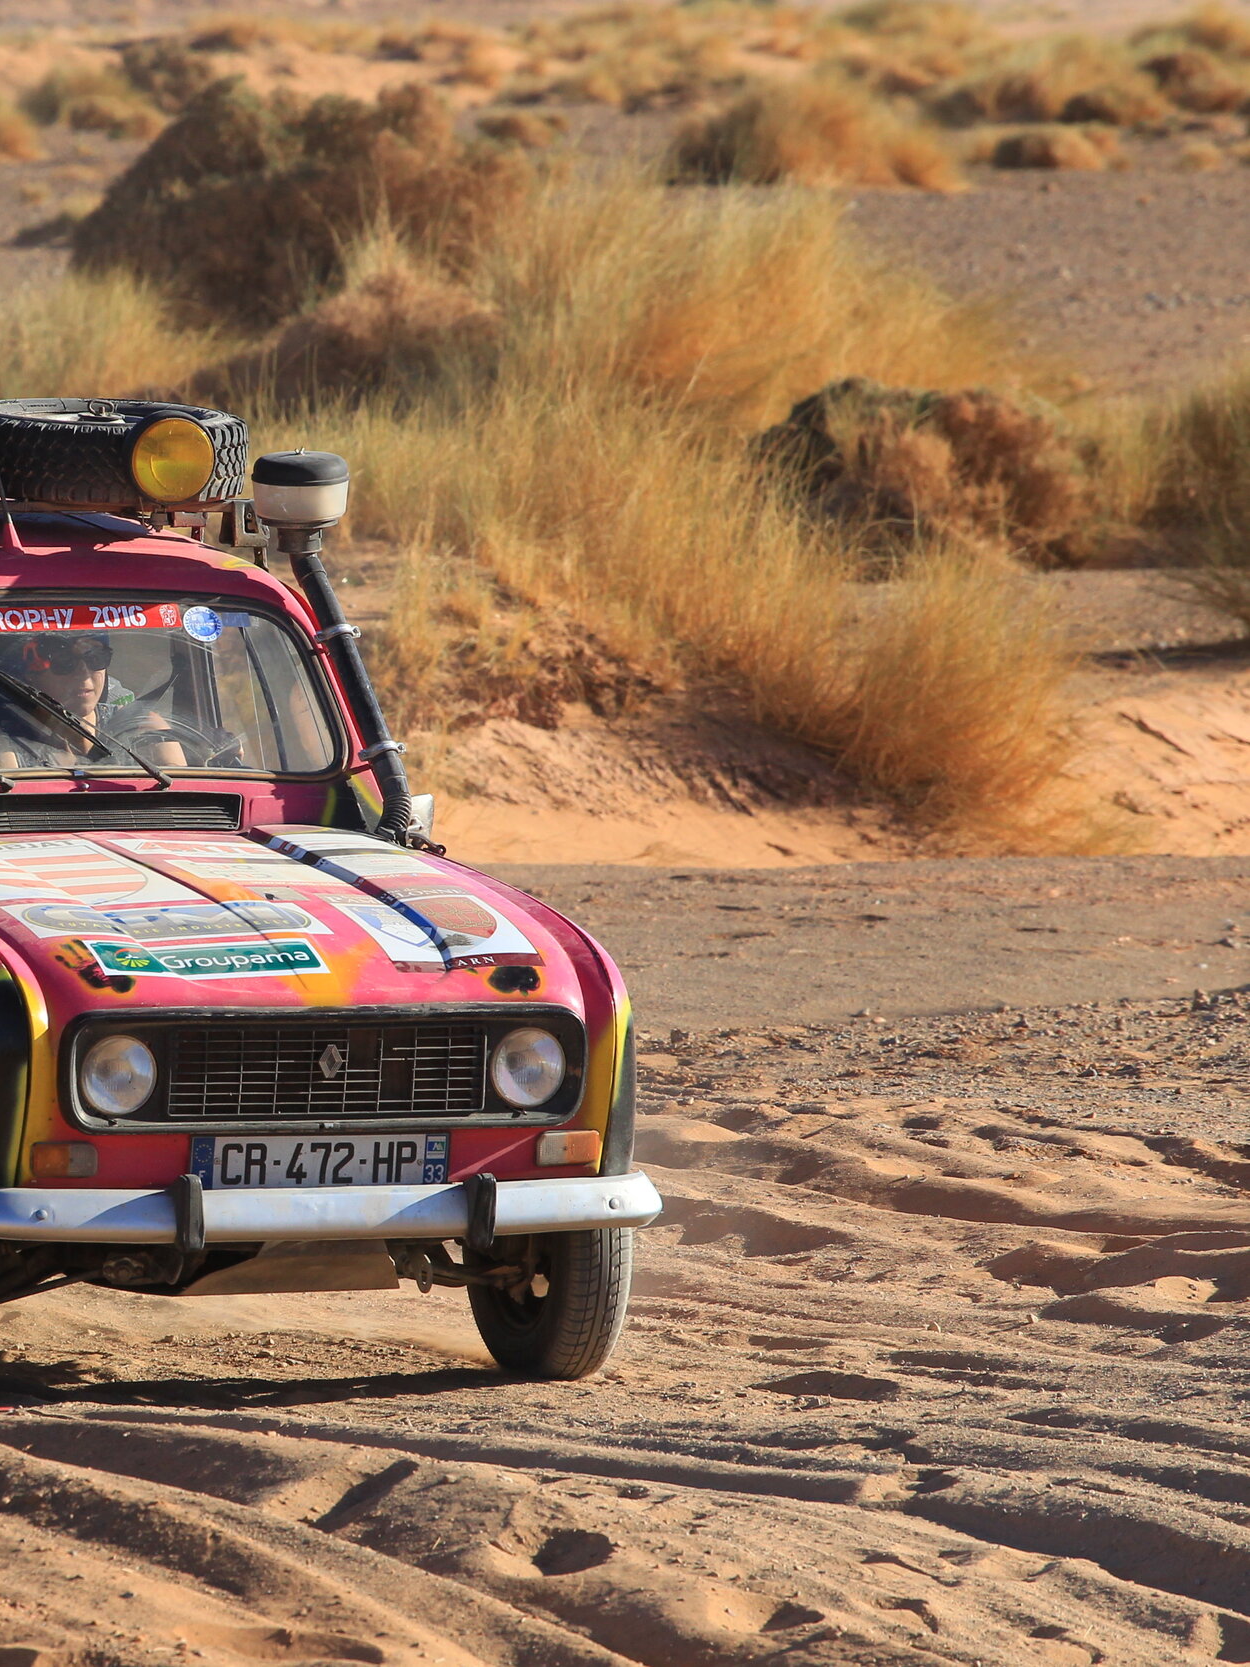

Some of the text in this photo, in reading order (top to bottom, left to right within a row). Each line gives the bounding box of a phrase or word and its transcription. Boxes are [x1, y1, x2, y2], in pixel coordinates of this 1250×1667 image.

[88, 604, 146, 628] 2016
[159, 950, 311, 970] Groupama
[424, 1163, 445, 1184] 33
